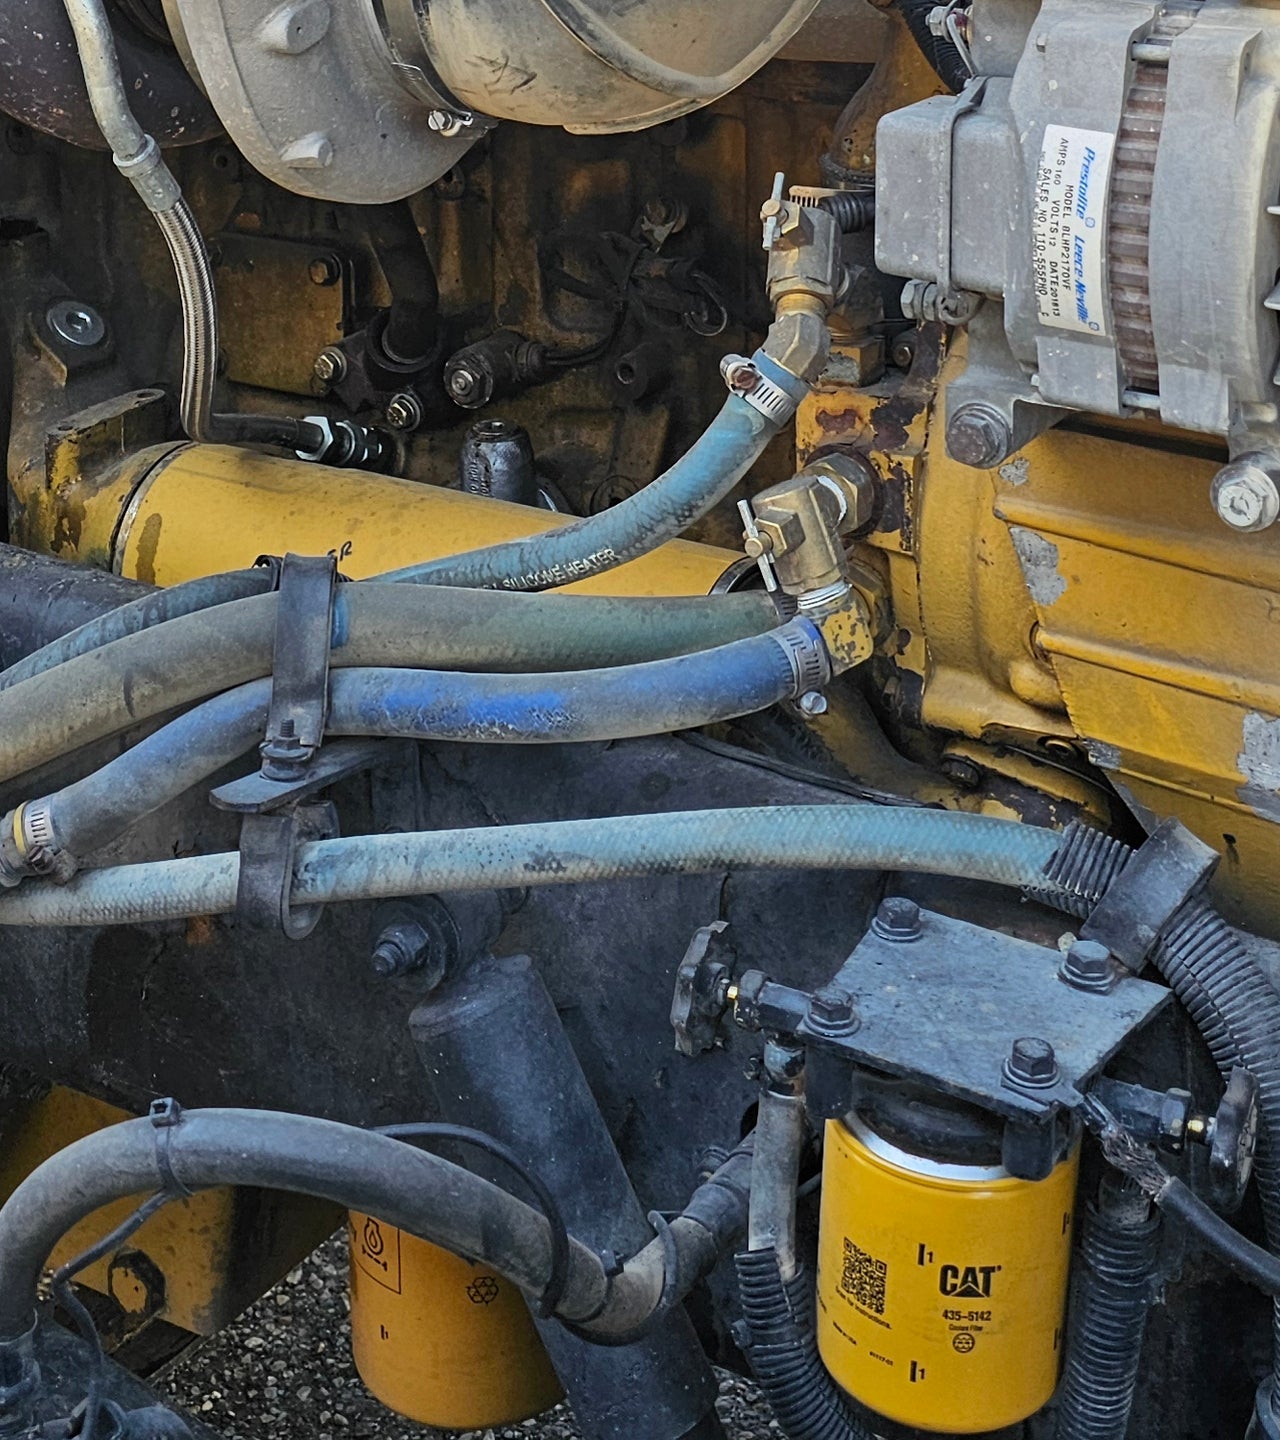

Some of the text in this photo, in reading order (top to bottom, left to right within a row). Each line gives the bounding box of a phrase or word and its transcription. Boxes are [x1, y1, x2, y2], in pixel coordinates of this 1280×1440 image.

[1057, 137, 1069, 166] AMPS
[1039, 167, 1052, 202] SALES
[1076, 146, 1096, 220] Prestolite
[1050, 200, 1061, 234] VOLTS
[1062, 184, 1074, 218] MODEL
[502, 548, 622, 590] SILICONE HEATER
[939, 1264, 996, 1298] CAT
[942, 1310, 992, 1322] 435-5142
